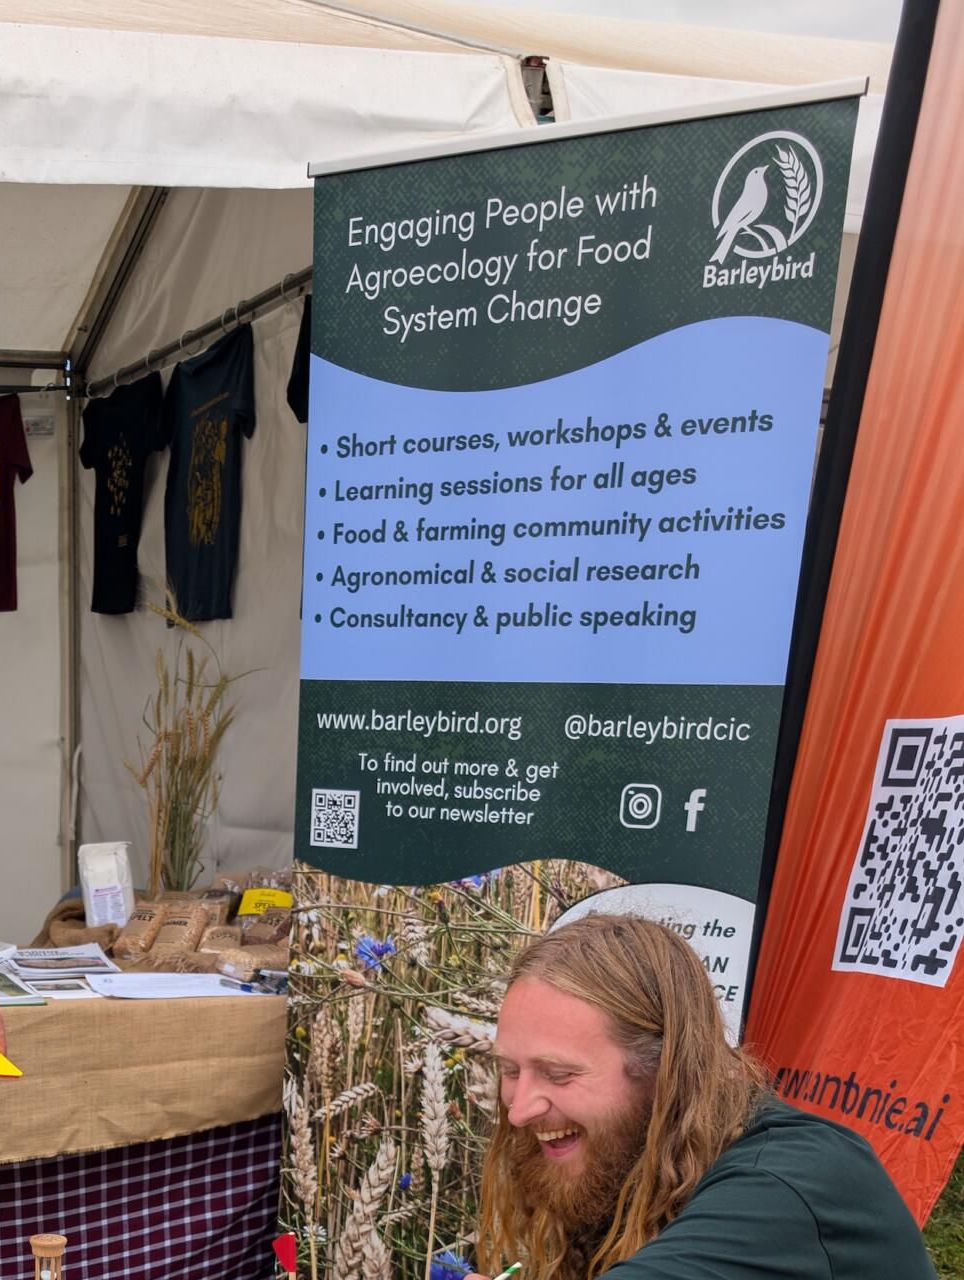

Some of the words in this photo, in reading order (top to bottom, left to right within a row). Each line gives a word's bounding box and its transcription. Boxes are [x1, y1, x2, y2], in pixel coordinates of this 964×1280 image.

[348, 209, 475, 252] Engaging
[486, 185, 584, 236] People
[596, 175, 658, 215] with
[345, 249, 518, 300] Agroecology
[527, 240, 568, 271] for
[577, 225, 651, 266] Food
[702, 252, 816, 289] Barleybird
[382, 301, 477, 342] System
[487, 290, 602, 326] Change
[336, 434, 396, 459] Short
[403, 431, 501, 455] courses,
[507, 416, 647, 449] workshops
[654, 412, 673, 438] &
[680, 409, 774, 437] events
[335, 475, 433, 505] Learning
[440, 471, 543, 497] sessions
[550, 466, 587, 492] for
[593, 462, 624, 490] all
[630, 465, 698, 494] ages
[332, 518, 386, 544] Food
[393, 518, 409, 543] &
[416, 518, 506, 546] farming
[513, 511, 652, 542] community
[658, 506, 786, 534] activities
[331, 560, 474, 592] Agronomical
[481, 561, 497, 583] &
[503, 556, 580, 583] social
[586, 553, 700, 582] research
[330, 605, 467, 634] Consultancy
[473, 605, 489, 628] &
[496, 602, 573, 634] public
[579, 600, 697, 634] speaking
[317, 709, 522, 740] www.barleybird.org
[564, 713, 751, 744] @barleybirdcic
[358, 753, 378, 772] To
[383, 753, 417, 774] find
[421, 757, 449, 774] out
[454, 760, 500, 776] more
[505, 759, 520, 778] &
[526, 760, 559, 784] get
[376, 778, 449, 800] involved,
[454, 781, 541, 802] subscribe
[386, 801, 403, 817] to
[408, 804, 435, 820] our
[439, 804, 535, 825] newsletter
[702, 919, 736, 938] the
